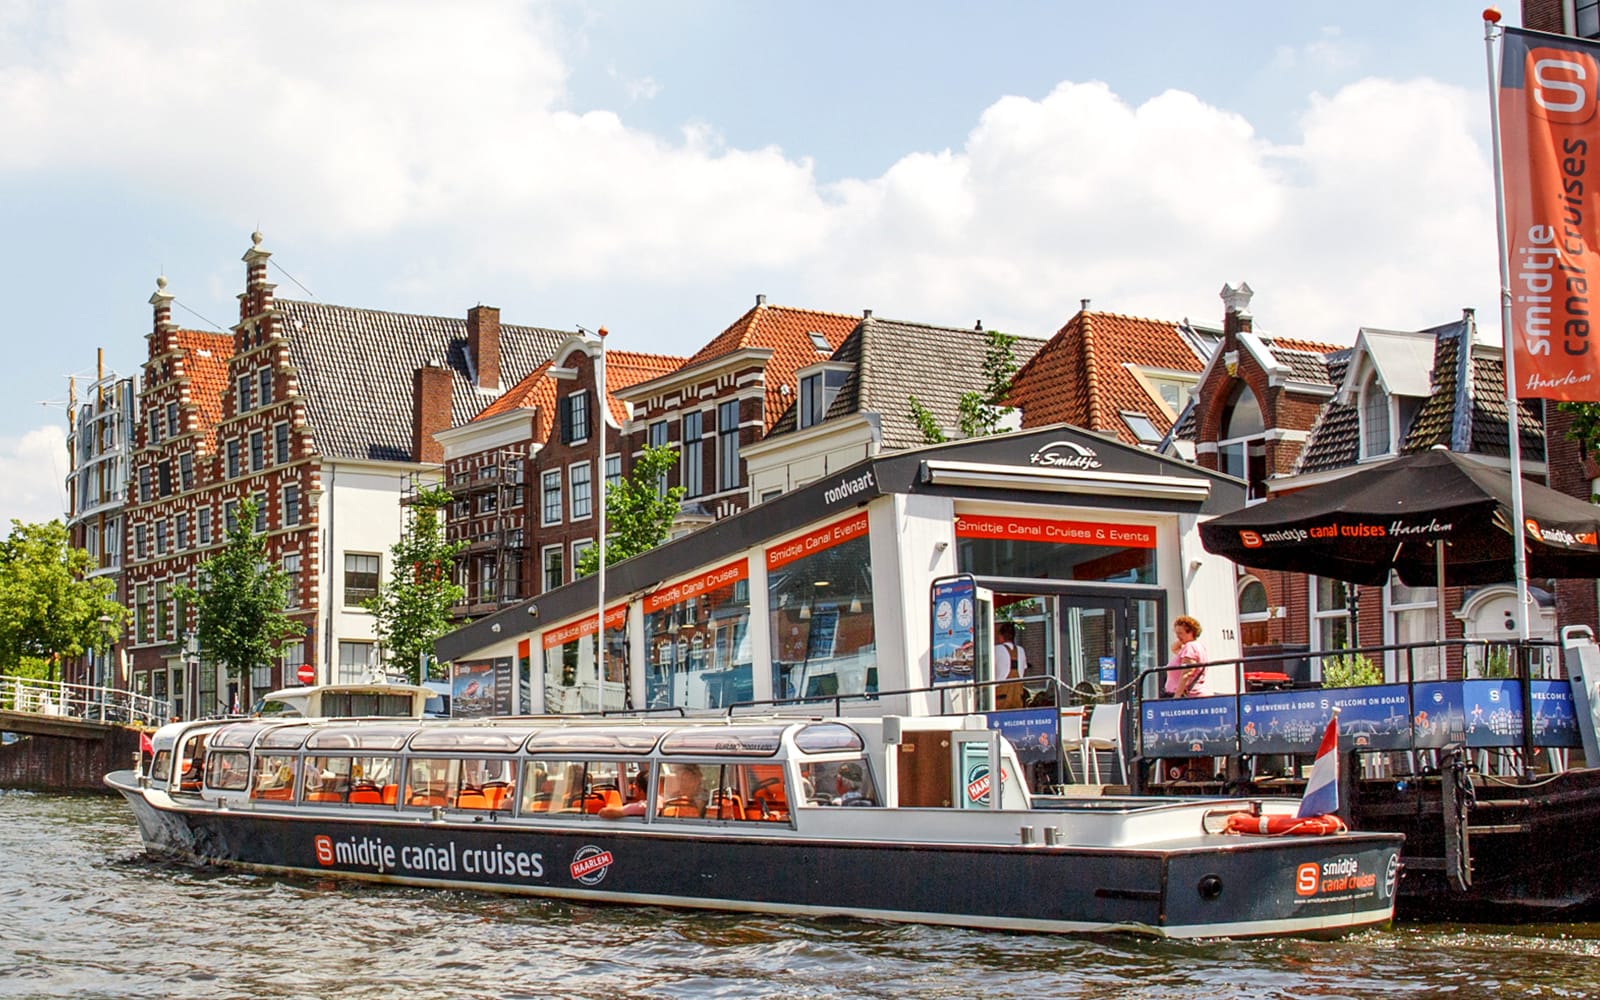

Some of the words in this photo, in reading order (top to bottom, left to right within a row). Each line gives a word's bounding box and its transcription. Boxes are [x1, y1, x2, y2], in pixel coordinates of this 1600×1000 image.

[1558, 138, 1587, 257] cruises
[1519, 225, 1562, 356] smidtje
[1558, 264, 1590, 356] canal
[1526, 369, 1592, 391] Haarlem
[1039, 452, 1102, 470] Smidtje
[824, 471, 874, 504] rondvaart
[957, 520, 1003, 533] Smidtje
[1008, 523, 1041, 535] Canal
[1046, 525, 1091, 538] Cruises
[1095, 530, 1105, 539] &
[1110, 530, 1149, 542] Events
[1262, 528, 1308, 543] smidtje
[1310, 523, 1338, 538] canal
[1341, 523, 1386, 537] cruises
[1389, 518, 1453, 536] Haarlem
[1540, 528, 1576, 546] smidtje
[770, 543, 803, 564] Smidtje
[805, 531, 831, 550] Canal
[834, 519, 867, 539] Events
[682, 578, 704, 596] Canal
[706, 567, 739, 587] Cruises
[1222, 629, 1235, 641] 11A
[1256, 702, 1290, 712] BIENVENUE
[1298, 702, 1316, 710] BORD
[1334, 698, 1366, 708] WELCOME
[1369, 697, 1379, 705] ON
[1381, 696, 1406, 705] BOARD
[1531, 692, 1566, 701] WELCOME
[1160, 708, 1199, 717] WILLKOMMEN
[1200, 707, 1209, 715] AN
[1210, 706, 1228, 714] BORD
[1003, 719, 1026, 727] WELCOME
[401, 842, 457, 872] canal
[462, 843, 544, 877] cruises
[573, 855, 610, 875] HAARLEM
[1322, 858, 1358, 876] smidtje
[1321, 874, 1348, 893] canal
[1349, 872, 1376, 890] cruises
